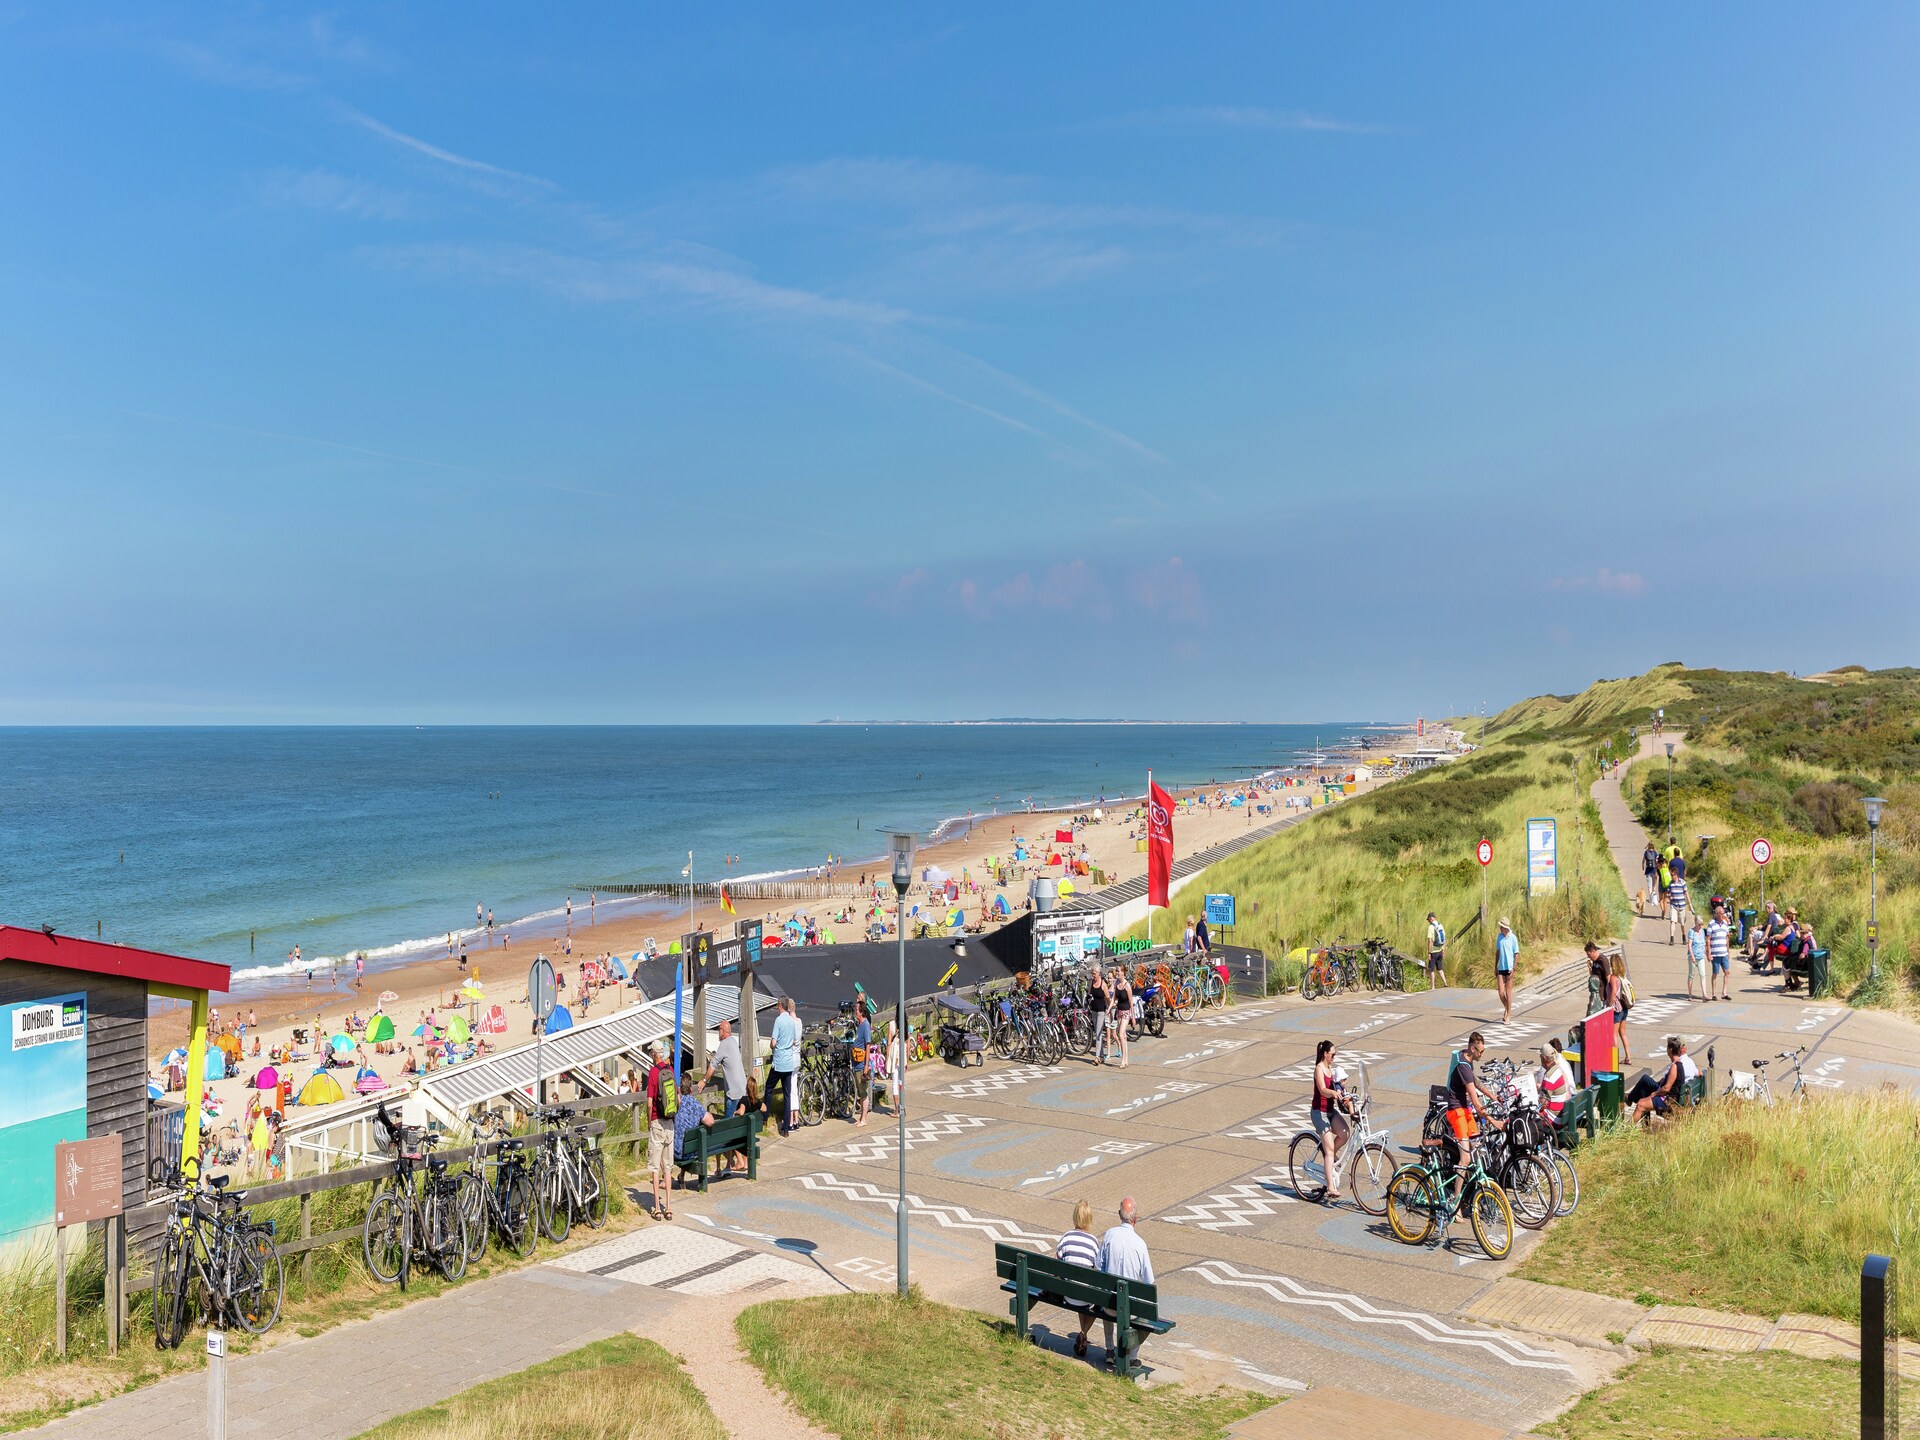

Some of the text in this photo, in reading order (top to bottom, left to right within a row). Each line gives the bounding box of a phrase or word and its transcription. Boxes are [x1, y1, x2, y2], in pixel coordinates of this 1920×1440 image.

[1208, 905, 1230, 914] STENEN
[1215, 914, 1230, 922] TOKO
[716, 944, 742, 968] WELKOM
[22, 1009, 54, 1031] DOMBURG
[14, 1036, 34, 1048] SCHOONSTE
[35, 1033, 48, 1044] STRAND
[48, 1031, 56, 1041] VAN
[56, 1027, 75, 1039] NEDERLAND
